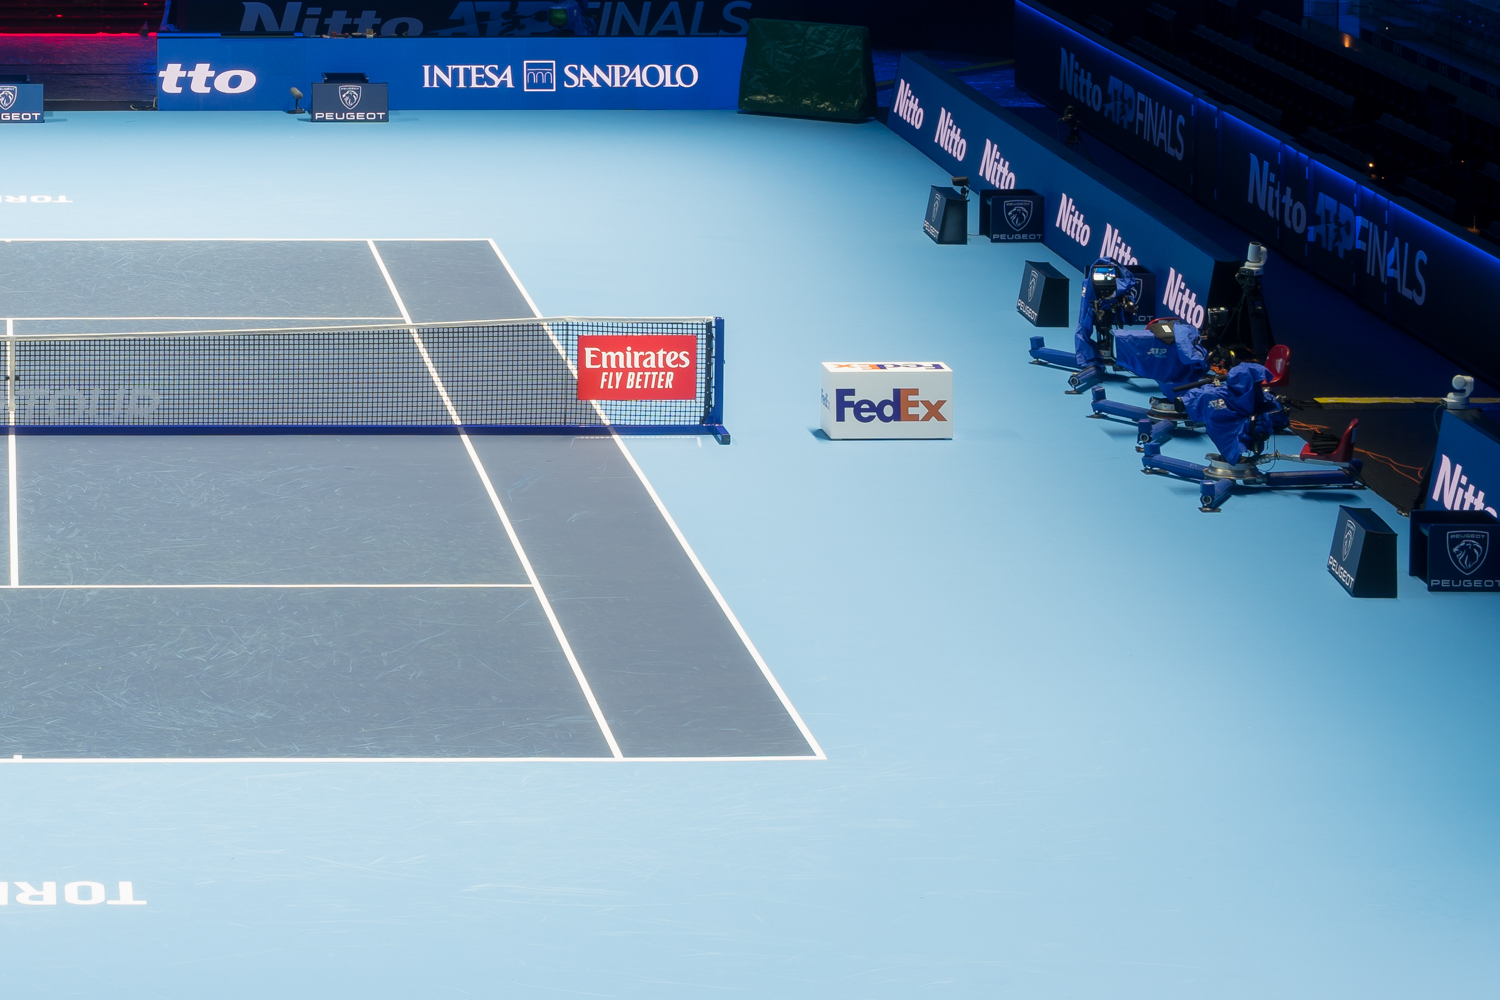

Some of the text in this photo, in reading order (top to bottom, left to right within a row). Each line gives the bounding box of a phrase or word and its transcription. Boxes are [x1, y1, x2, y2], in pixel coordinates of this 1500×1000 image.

[239, 1, 424, 37] Nitto
[158, 63, 257, 95] tto
[422, 63, 700, 89] INTESA SANPAOLO
[315, 112, 385, 120] PEUGEOT
[893, 78, 924, 130] Nitto
[1059, 46, 1186, 161] Nitto ATP FINALS
[934, 106, 967, 162] Nitto
[978, 138, 1016, 190] Nitto
[1247, 152, 1307, 235] Nitto
[1055, 192, 1091, 247] Nitto
[1017, 298, 1038, 322] PEUGEOT
[1162, 266, 1205, 329] Nitto
[584, 346, 690, 369] Emirates
[600, 371, 674, 389] FLY BETTER
[835, 388, 948, 423] FedEx
[1328, 555, 1355, 589] PEUGEOT
